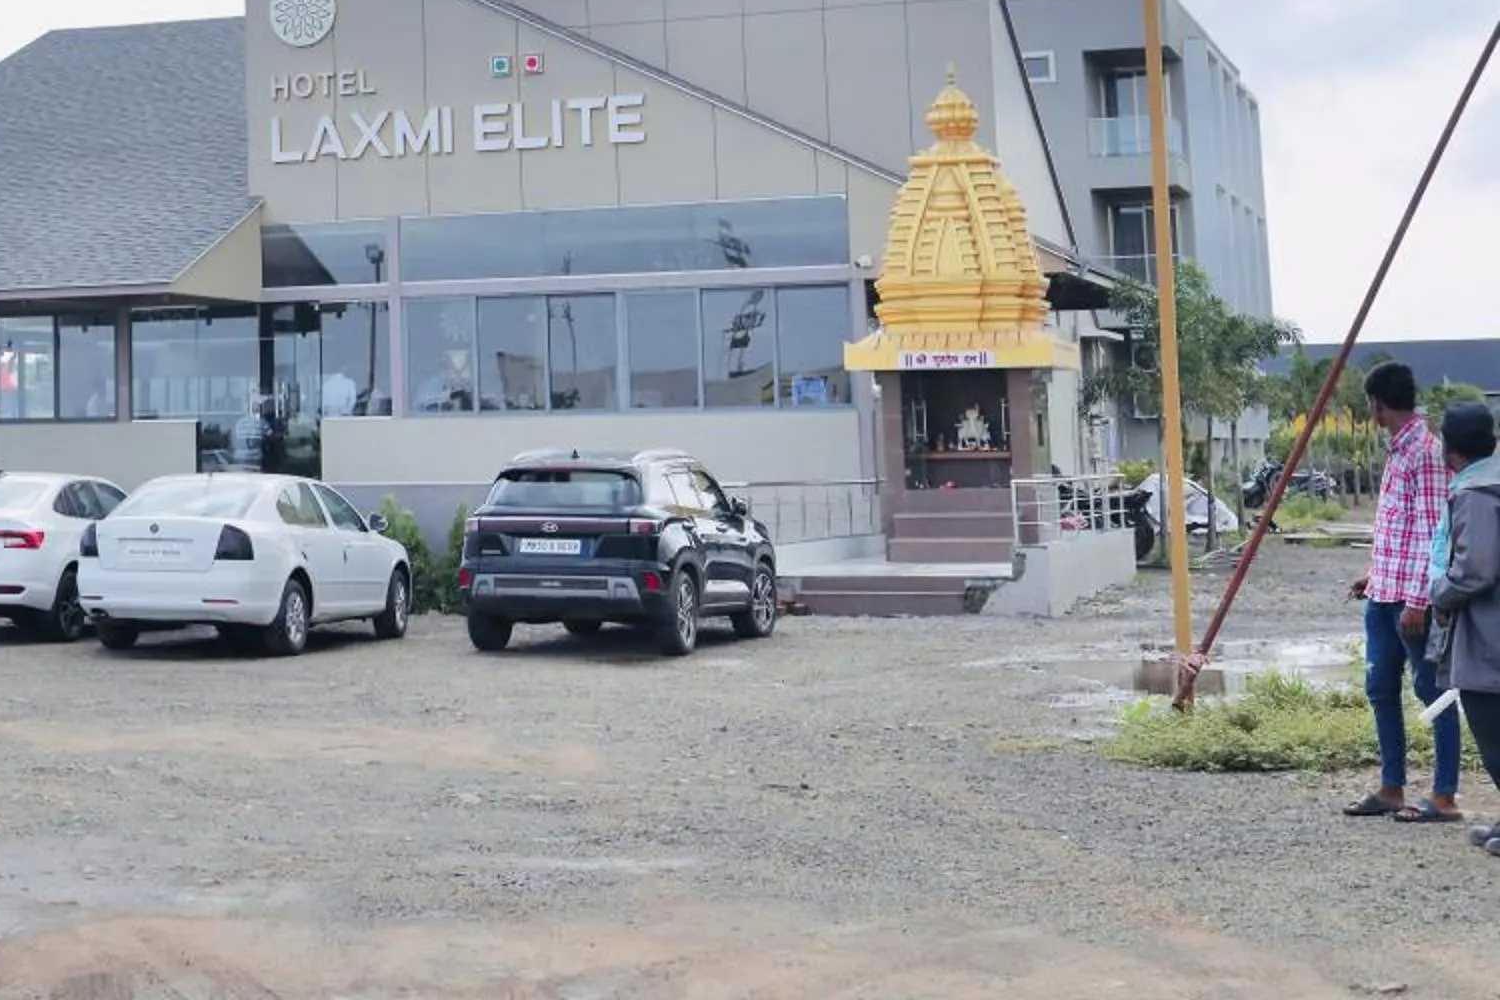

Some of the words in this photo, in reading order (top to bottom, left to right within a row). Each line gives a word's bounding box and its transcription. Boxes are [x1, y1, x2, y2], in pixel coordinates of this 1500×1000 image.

[271, 69, 376, 100] HOTEL
[271, 106, 454, 164] LAXMI
[474, 94, 646, 152] ELITE
